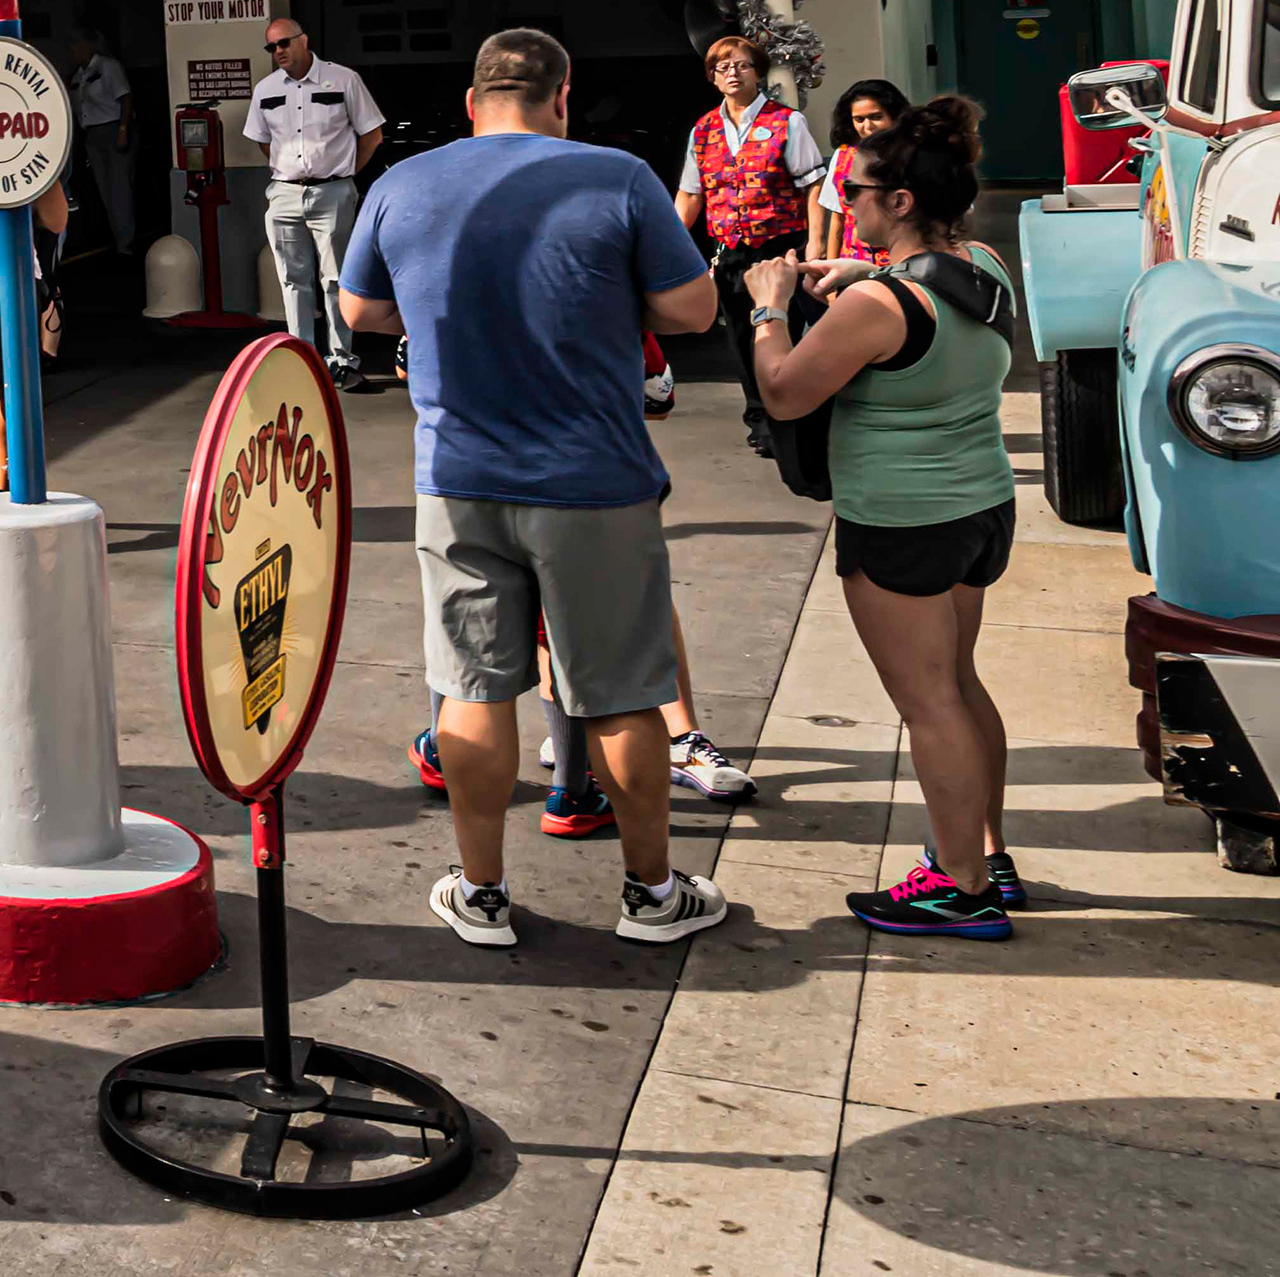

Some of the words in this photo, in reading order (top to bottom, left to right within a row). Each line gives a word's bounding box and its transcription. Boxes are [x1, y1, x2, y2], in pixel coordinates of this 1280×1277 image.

[168, 3, 193, 22] STOP
[198, 1, 224, 20] YOUR
[4, 53, 50, 100] RENTAL
[1, 173, 18, 193] OF
[20, 150, 50, 185] STAY
[240, 554, 287, 633] ETHYL
